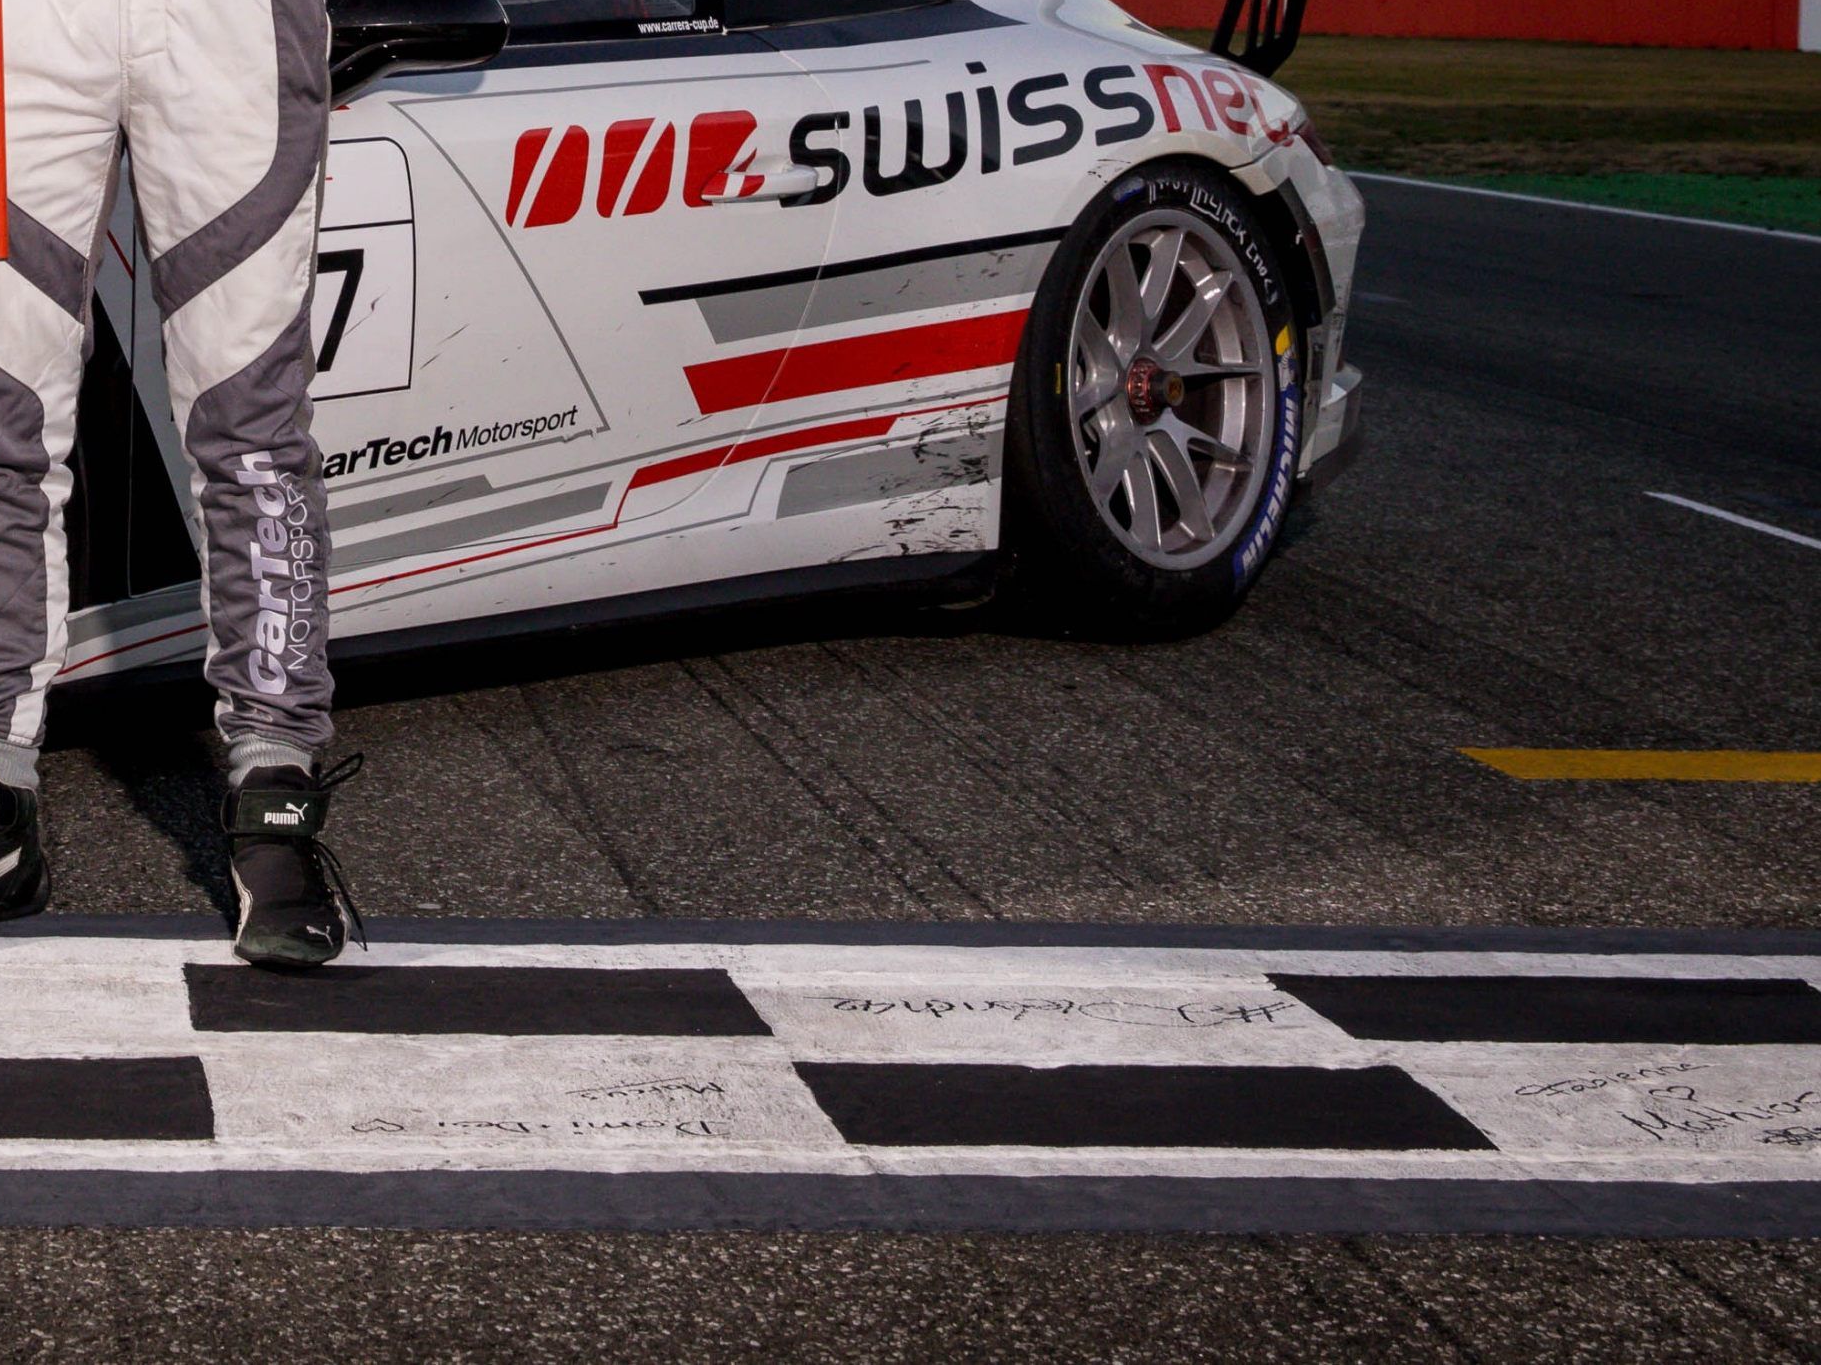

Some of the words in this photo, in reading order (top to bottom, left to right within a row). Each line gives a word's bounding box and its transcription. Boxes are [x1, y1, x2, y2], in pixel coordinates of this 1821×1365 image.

[637, 15, 720, 34] www.carrera-cup.de
[779, 61, 1297, 209] swissnet
[319, 425, 453, 480] arTech
[456, 405, 578, 452] Motorsport
[235, 450, 290, 695] CarTech
[264, 811, 299, 825] PUMA
